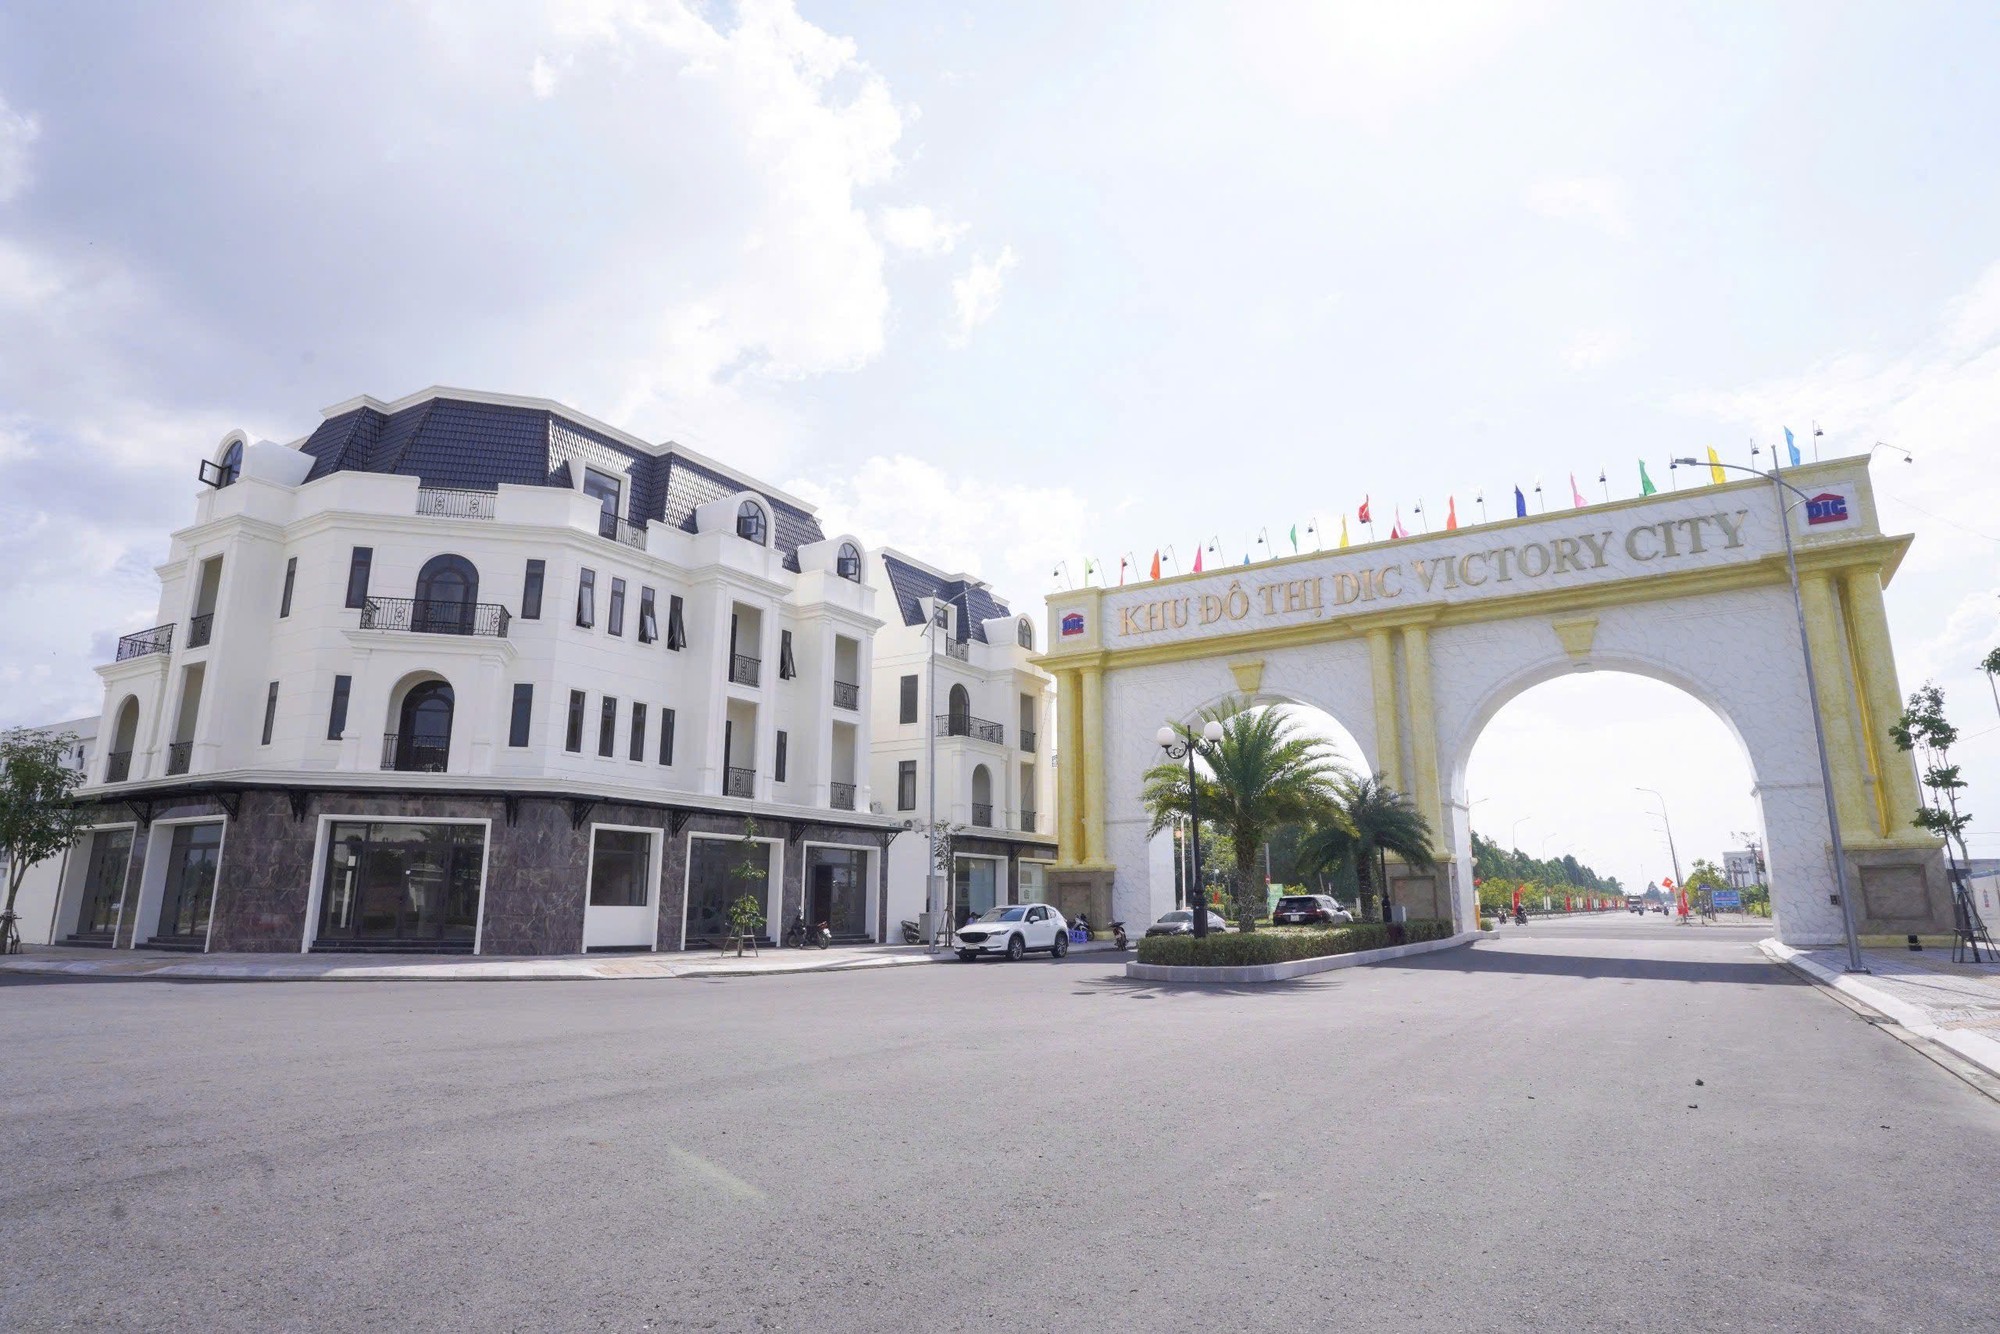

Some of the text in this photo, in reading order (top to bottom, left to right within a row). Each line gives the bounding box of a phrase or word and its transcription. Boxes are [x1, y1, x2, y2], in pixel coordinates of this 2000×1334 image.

[1805, 499, 1847, 518] DIC
[1117, 509, 1748, 636] KHU ĐÔ THỊ DIC VICTORY CITY
[1062, 617, 1085, 632] DIC
